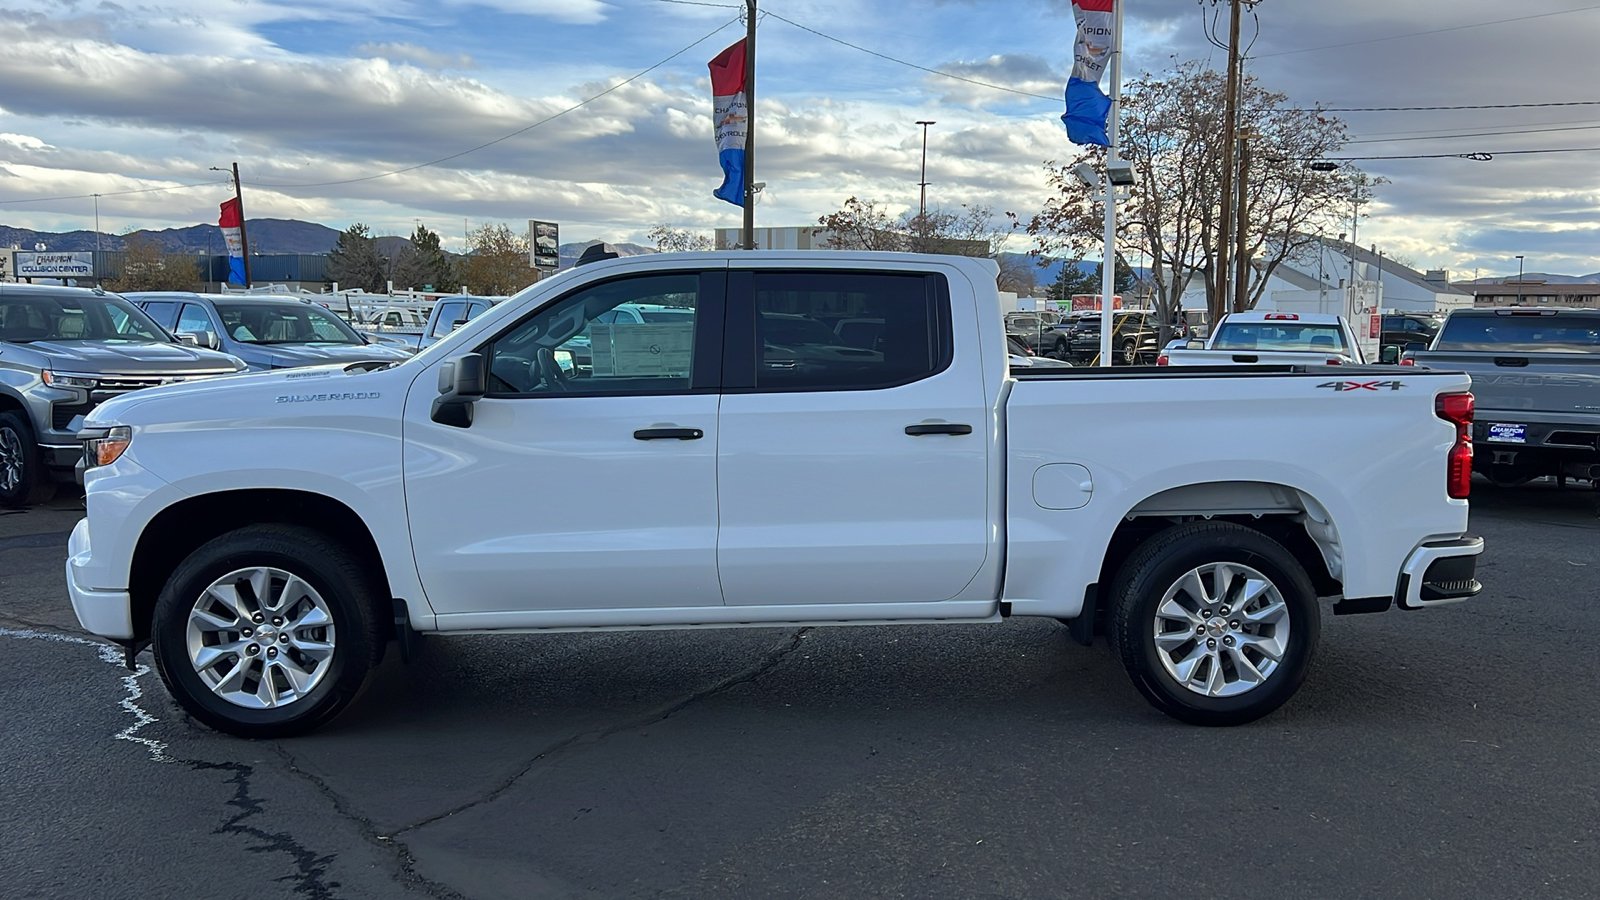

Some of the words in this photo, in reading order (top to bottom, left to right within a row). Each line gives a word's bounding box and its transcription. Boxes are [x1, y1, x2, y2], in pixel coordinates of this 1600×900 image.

[36, 255, 72, 265] CHAMPION
[22, 265, 57, 273] COLLISION
[58, 265, 88, 273] CENTER
[275, 392, 381, 404] SILVERADO
